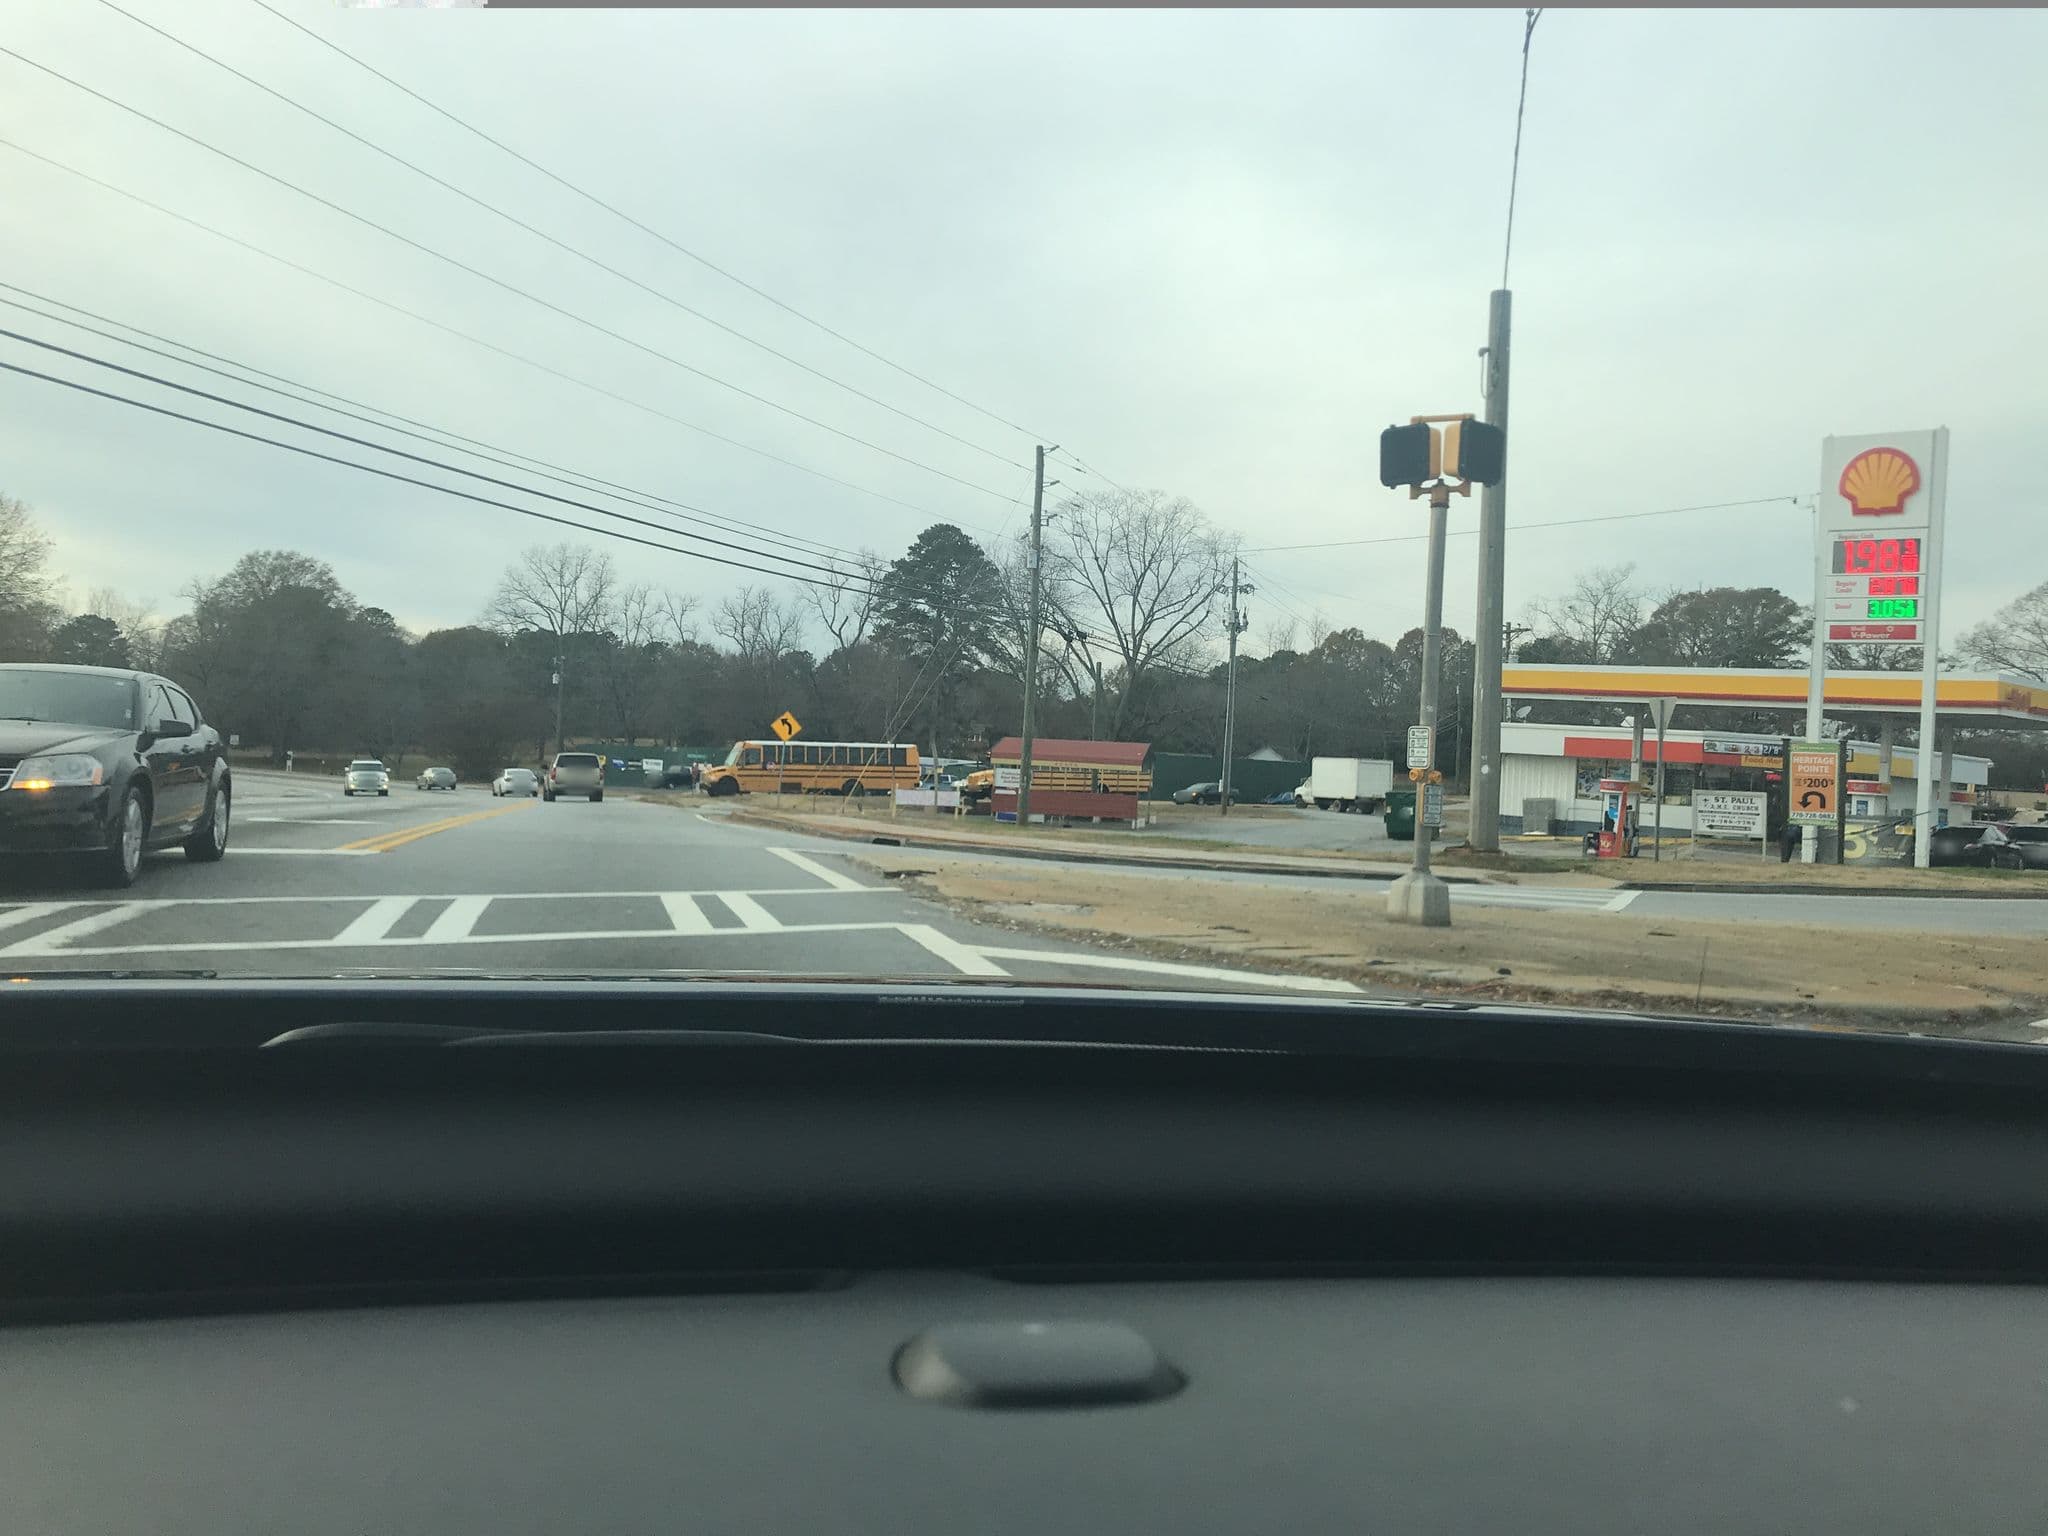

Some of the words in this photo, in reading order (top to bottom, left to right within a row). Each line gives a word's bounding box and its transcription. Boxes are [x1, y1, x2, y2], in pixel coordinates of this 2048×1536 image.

[1793, 756, 1834, 764] HERITAGE
[1798, 765, 1829, 773] POINTE
[1731, 797, 1755, 805] PAUL
